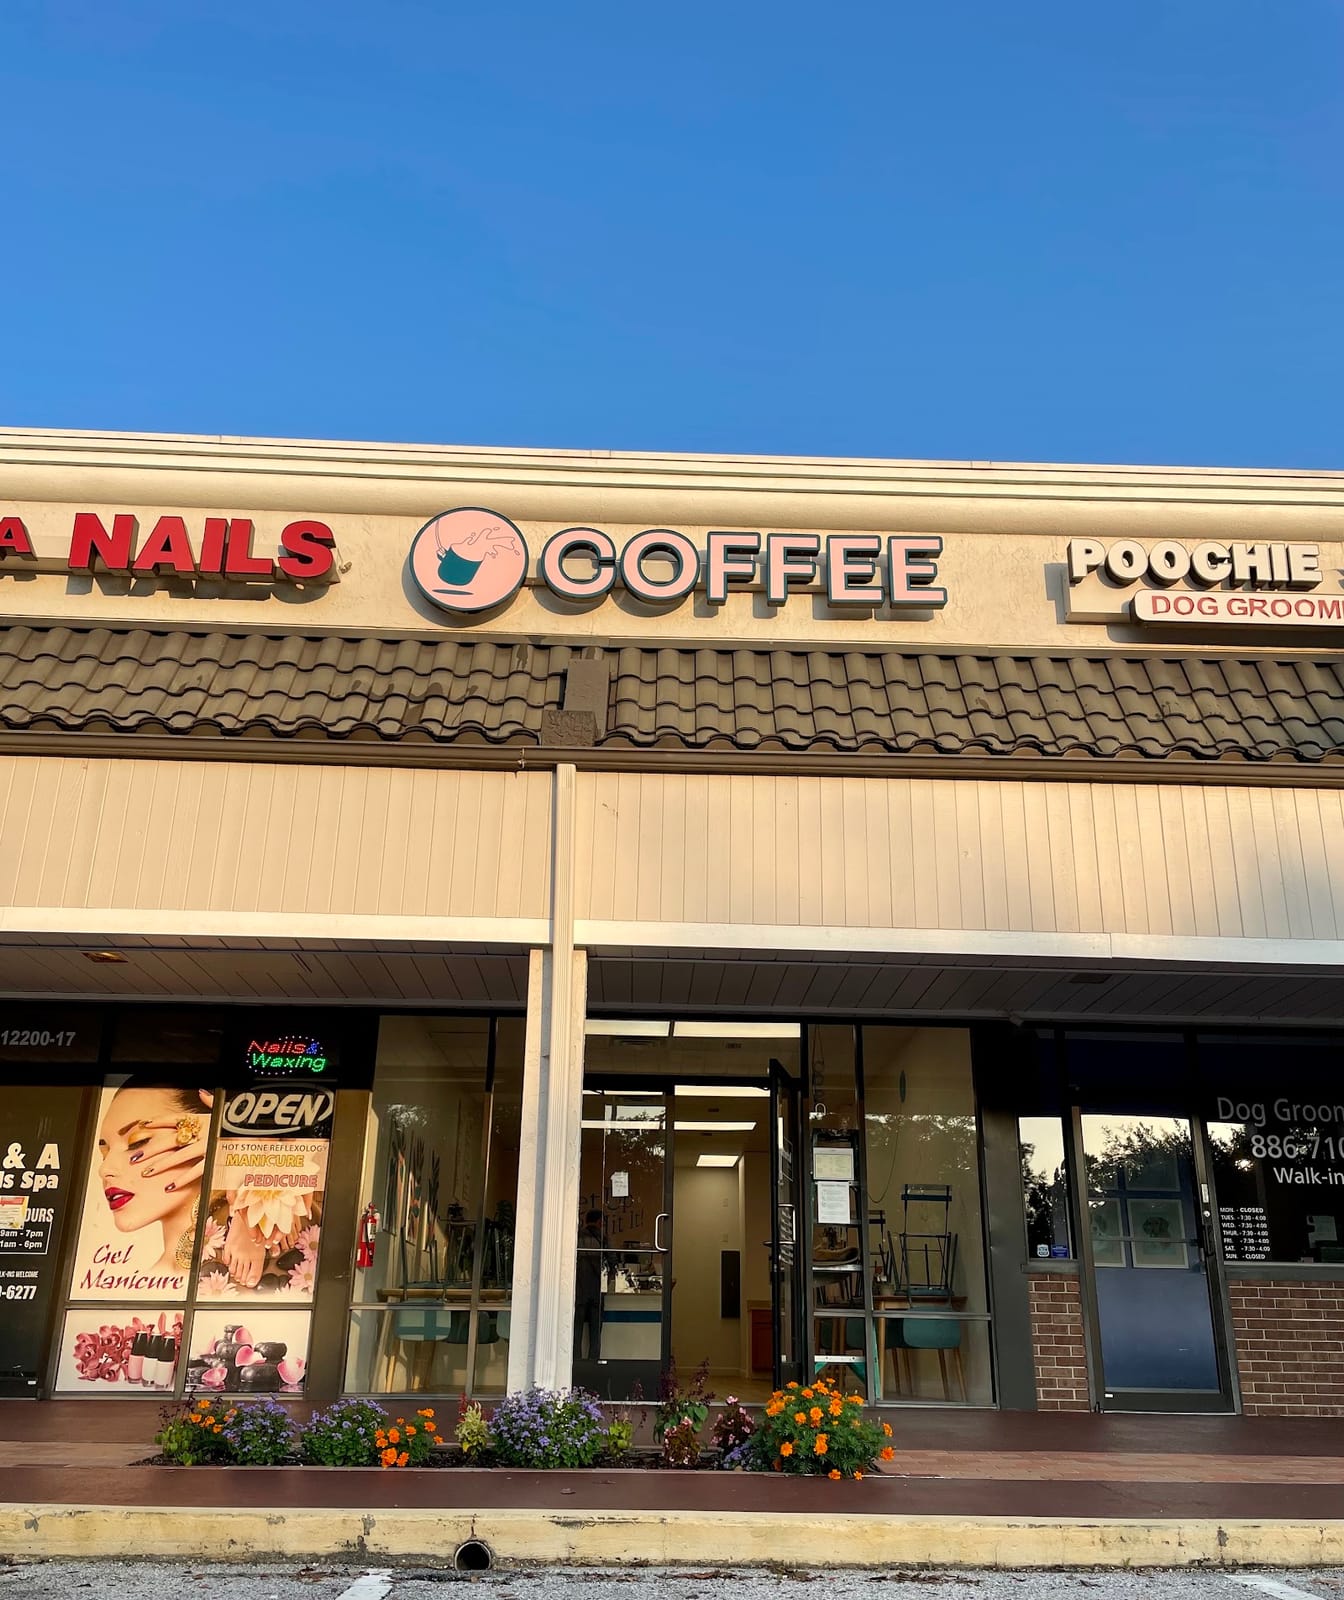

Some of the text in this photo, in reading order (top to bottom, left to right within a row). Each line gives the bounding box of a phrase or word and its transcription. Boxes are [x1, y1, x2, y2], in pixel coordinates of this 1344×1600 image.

[68, 513, 335, 578] NAILS
[541, 527, 948, 608] COFFEE
[1068, 538, 1323, 586] POOCHIE
[1151, 595, 1219, 616] DOG
[0, 1030, 77, 1047] 12200-17
[252, 1052, 327, 1073] Waxing
[227, 1092, 326, 1126] OPEN
[1216, 1096, 1266, 1127] Dog
[2, 1142, 60, 1170] & A
[221, 1143, 327, 1153] HOT STONE REFLEXOLOGY
[225, 1153, 305, 1168] MANICURE
[20, 1170, 59, 1193] Spa
[244, 1174, 318, 1188] PEDICURE
[24, 1207, 55, 1223] OURS
[25, 1229, 44, 1239] 7pm
[24, 1240, 43, 1250] 6pm
[93, 1243, 134, 1265] Gel
[15, 1270, 39, 1278] WELCOME
[80, 1268, 184, 1290] Manicure
